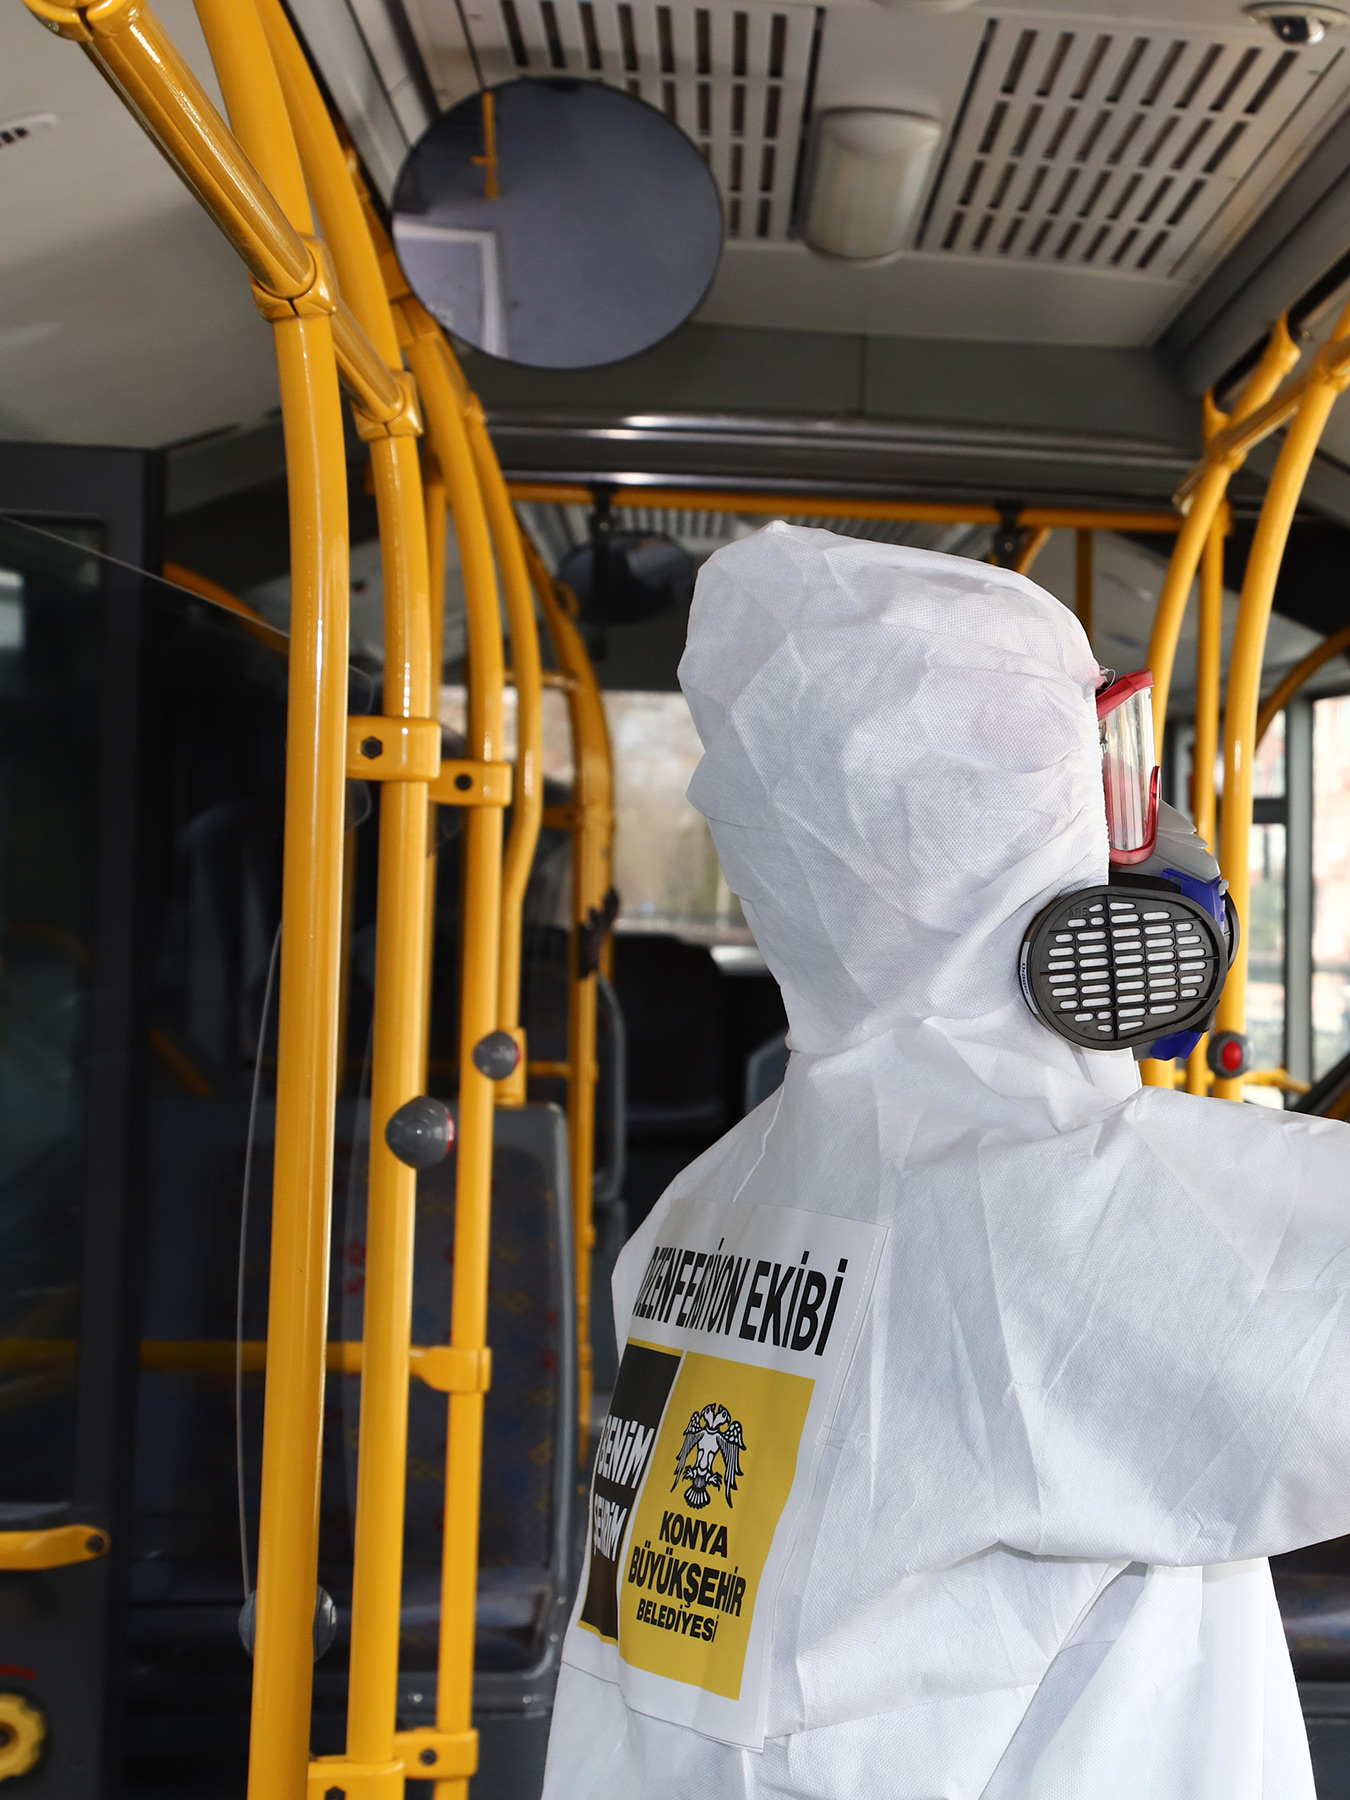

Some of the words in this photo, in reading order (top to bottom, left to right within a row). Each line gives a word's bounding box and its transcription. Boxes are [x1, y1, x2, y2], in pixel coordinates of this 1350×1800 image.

[738, 1250, 848, 1356] EKİBİ
[658, 1510, 728, 1558] KONYA
[627, 1540, 747, 1617] BÜYÜKŞEHİR
[635, 1597, 719, 1643] BELEDİYESİ
